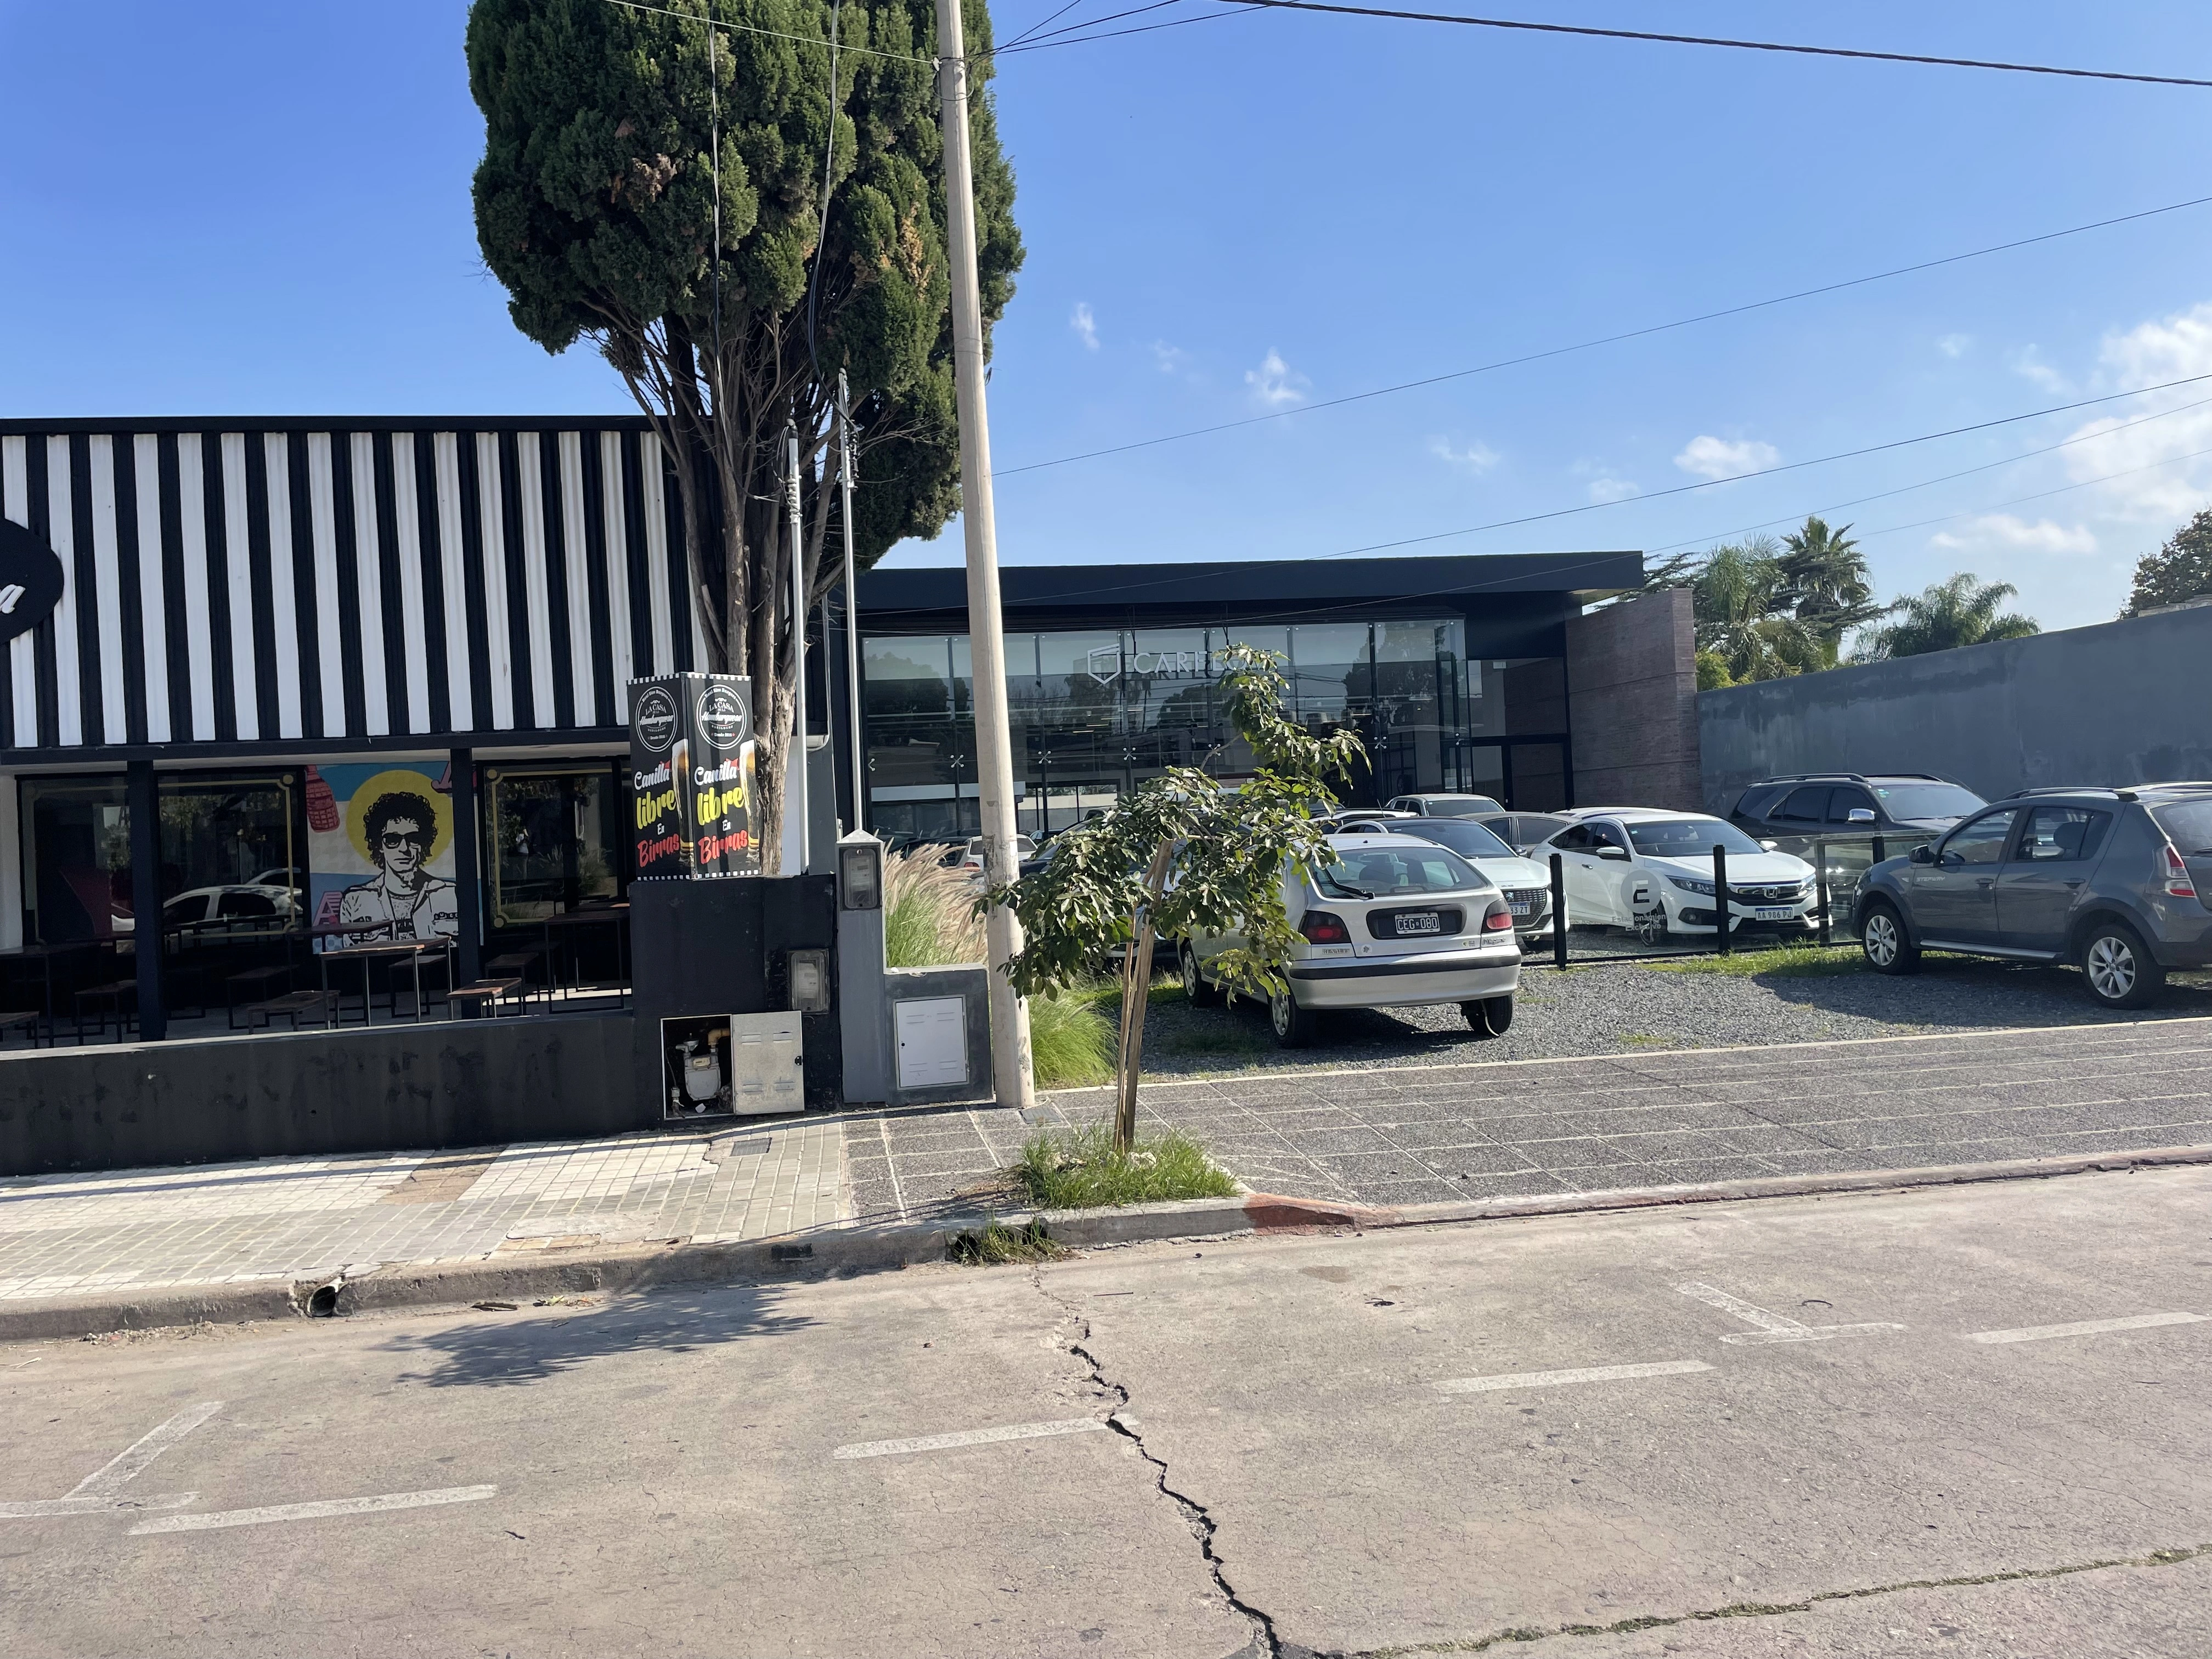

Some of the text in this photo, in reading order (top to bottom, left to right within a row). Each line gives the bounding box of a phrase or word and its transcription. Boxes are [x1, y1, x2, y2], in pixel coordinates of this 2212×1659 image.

[1133, 651, 1276, 674] CARFLO
[645, 704, 667, 715] LA CASA
[709, 702, 735, 713] LA CASA
[639, 714, 674, 726] Hamburguesa
[701, 711, 742, 725] Hamburguesa
[634, 763, 670, 790] Canilla
[695, 760, 737, 786] Canilla
[636, 790, 676, 830] libre
[697, 787, 745, 826] libre
[657, 823, 665, 835] En
[722, 819, 731, 831] En
[637, 833, 680, 868] Birras
[698, 830, 748, 865] Birras
[1632, 879, 1650, 904] E
[1397, 918, 1415, 930] CEG
[1420, 917, 1438, 929] 080
[1611, 913, 1674, 923] Estaconamieno
[1625, 922, 1662, 932] Exclsvo
